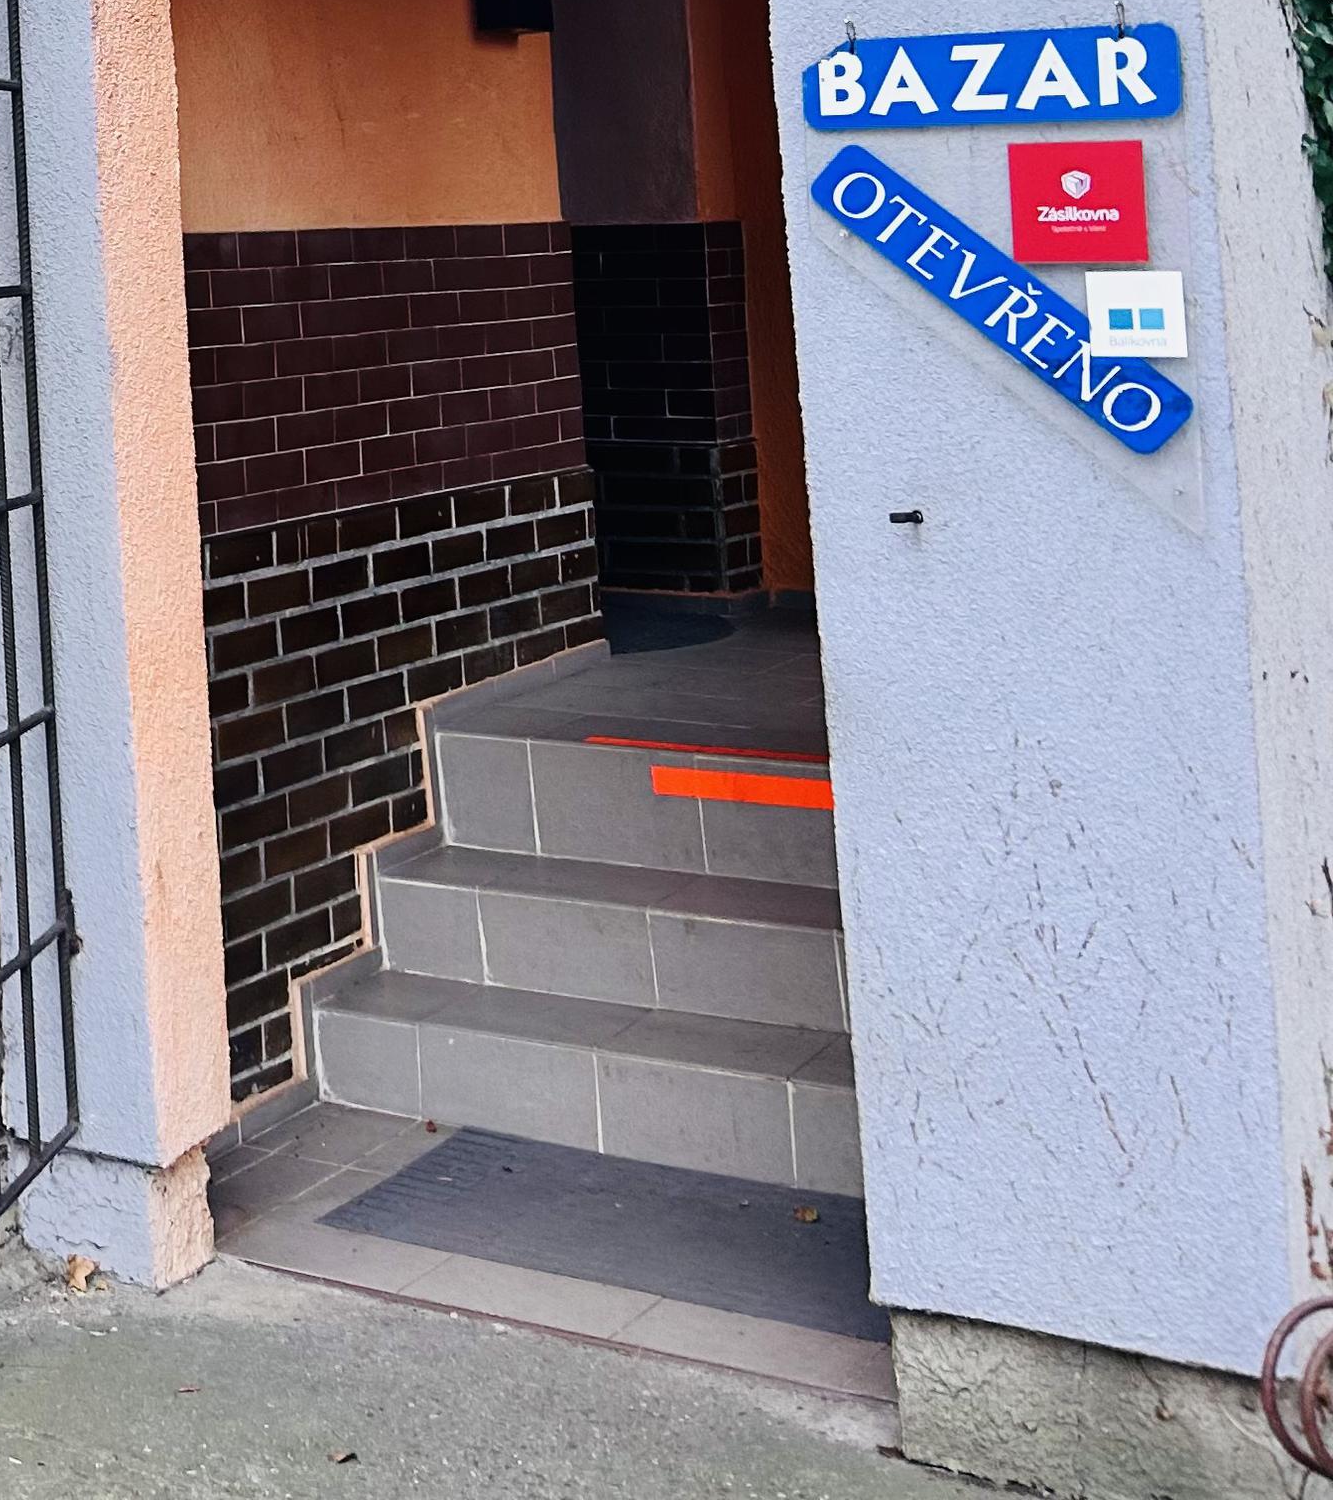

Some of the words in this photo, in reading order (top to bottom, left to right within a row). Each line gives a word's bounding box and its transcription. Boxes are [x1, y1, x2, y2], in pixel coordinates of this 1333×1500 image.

[817, 36, 1157, 117] BAZAR
[1036, 206, 1120, 222] Zásilkovna
[832, 171, 1163, 433] OTEVŘENO
